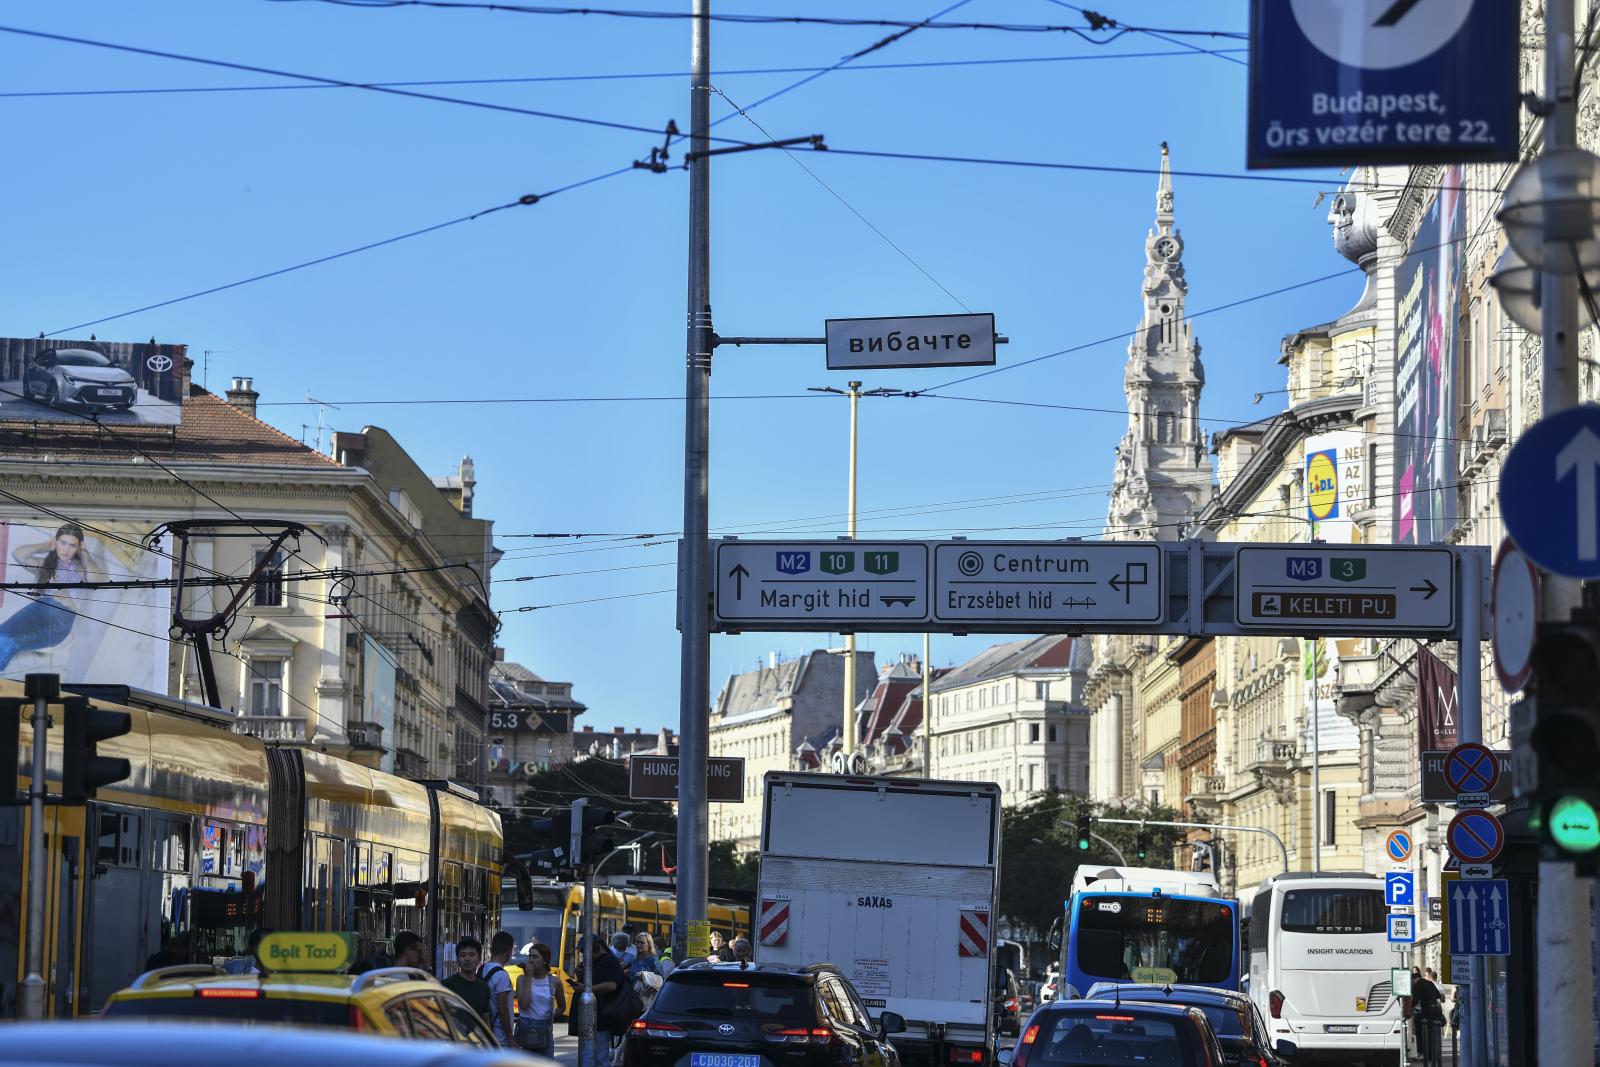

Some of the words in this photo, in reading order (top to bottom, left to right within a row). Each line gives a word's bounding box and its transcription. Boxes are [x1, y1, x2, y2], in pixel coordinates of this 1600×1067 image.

[1312, 91, 1447, 118] Budapest,
[1316, 120, 1388, 144] vezér
[1396, 120, 1451, 142] tere
[1459, 120, 1496, 142] 22.
[850, 331, 971, 353] вибачте
[1345, 465, 1360, 480] AZ
[781, 554, 806, 570] M2
[829, 554, 846, 570] 10
[875, 554, 888, 570] 11
[993, 554, 1089, 573] Centrum
[1291, 560, 1317, 576] M3
[1342, 561, 1355, 577] 3
[760, 589, 830, 612] Margit
[948, 590, 1021, 609] Erzsébet
[1289, 598, 1352, 614] KELETI
[1361, 599, 1391, 614] PU.
[491, 713, 519, 728] 5.3
[643, 762, 731, 777] HUNGRING
[1392, 883, 1407, 902] P
[857, 896, 893, 908] SAXAS
[270, 944, 301, 962] Bolt
[304, 944, 337, 959] Taxi
